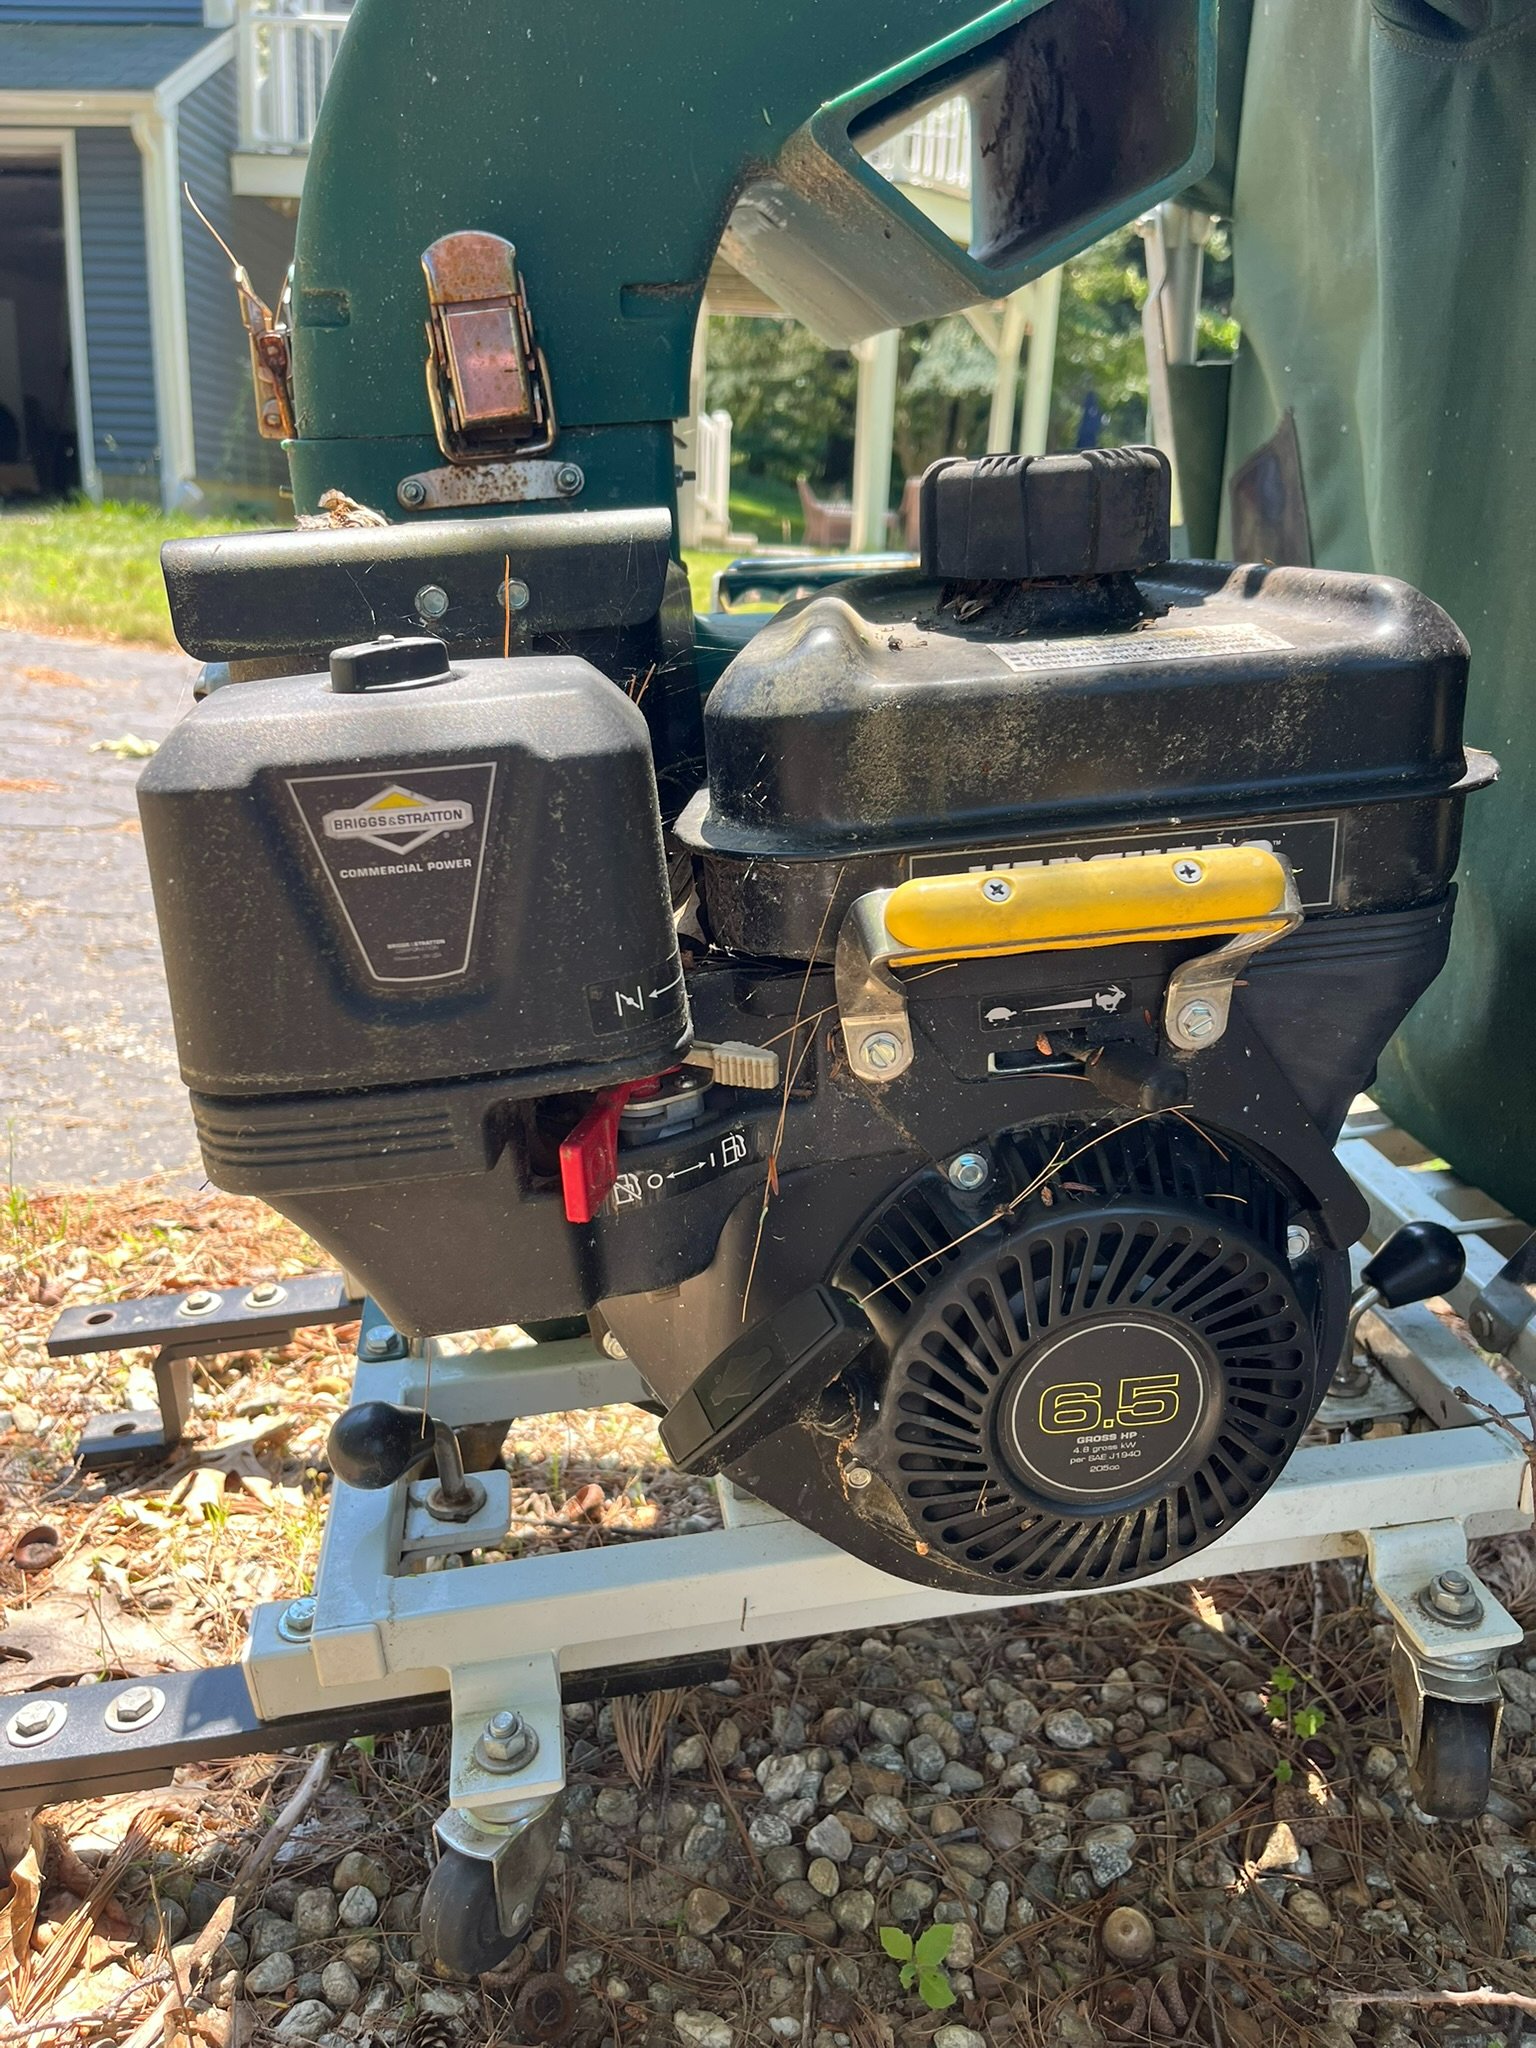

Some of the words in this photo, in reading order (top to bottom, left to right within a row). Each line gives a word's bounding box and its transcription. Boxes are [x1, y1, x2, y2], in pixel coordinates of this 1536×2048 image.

[333, 809, 463, 831] BRIGGS&STRATTON
[339, 863, 423, 879] COMMERCIAL
[427, 858, 472, 872] POWER
[1038, 1373, 1180, 1435] 6.5
[1076, 1433, 1117, 1444] GROSS
[1120, 1431, 1138, 1440] HP
[1072, 1445, 1090, 1454] 4.8
[1092, 1444, 1118, 1454] gross
[1120, 1441, 1137, 1449] kW
[1069, 1456, 1086, 1465] per
[1088, 1453, 1107, 1462] SAE
[1108, 1450, 1141, 1460] J1940
[1089, 1464, 1121, 1473] 205cc
